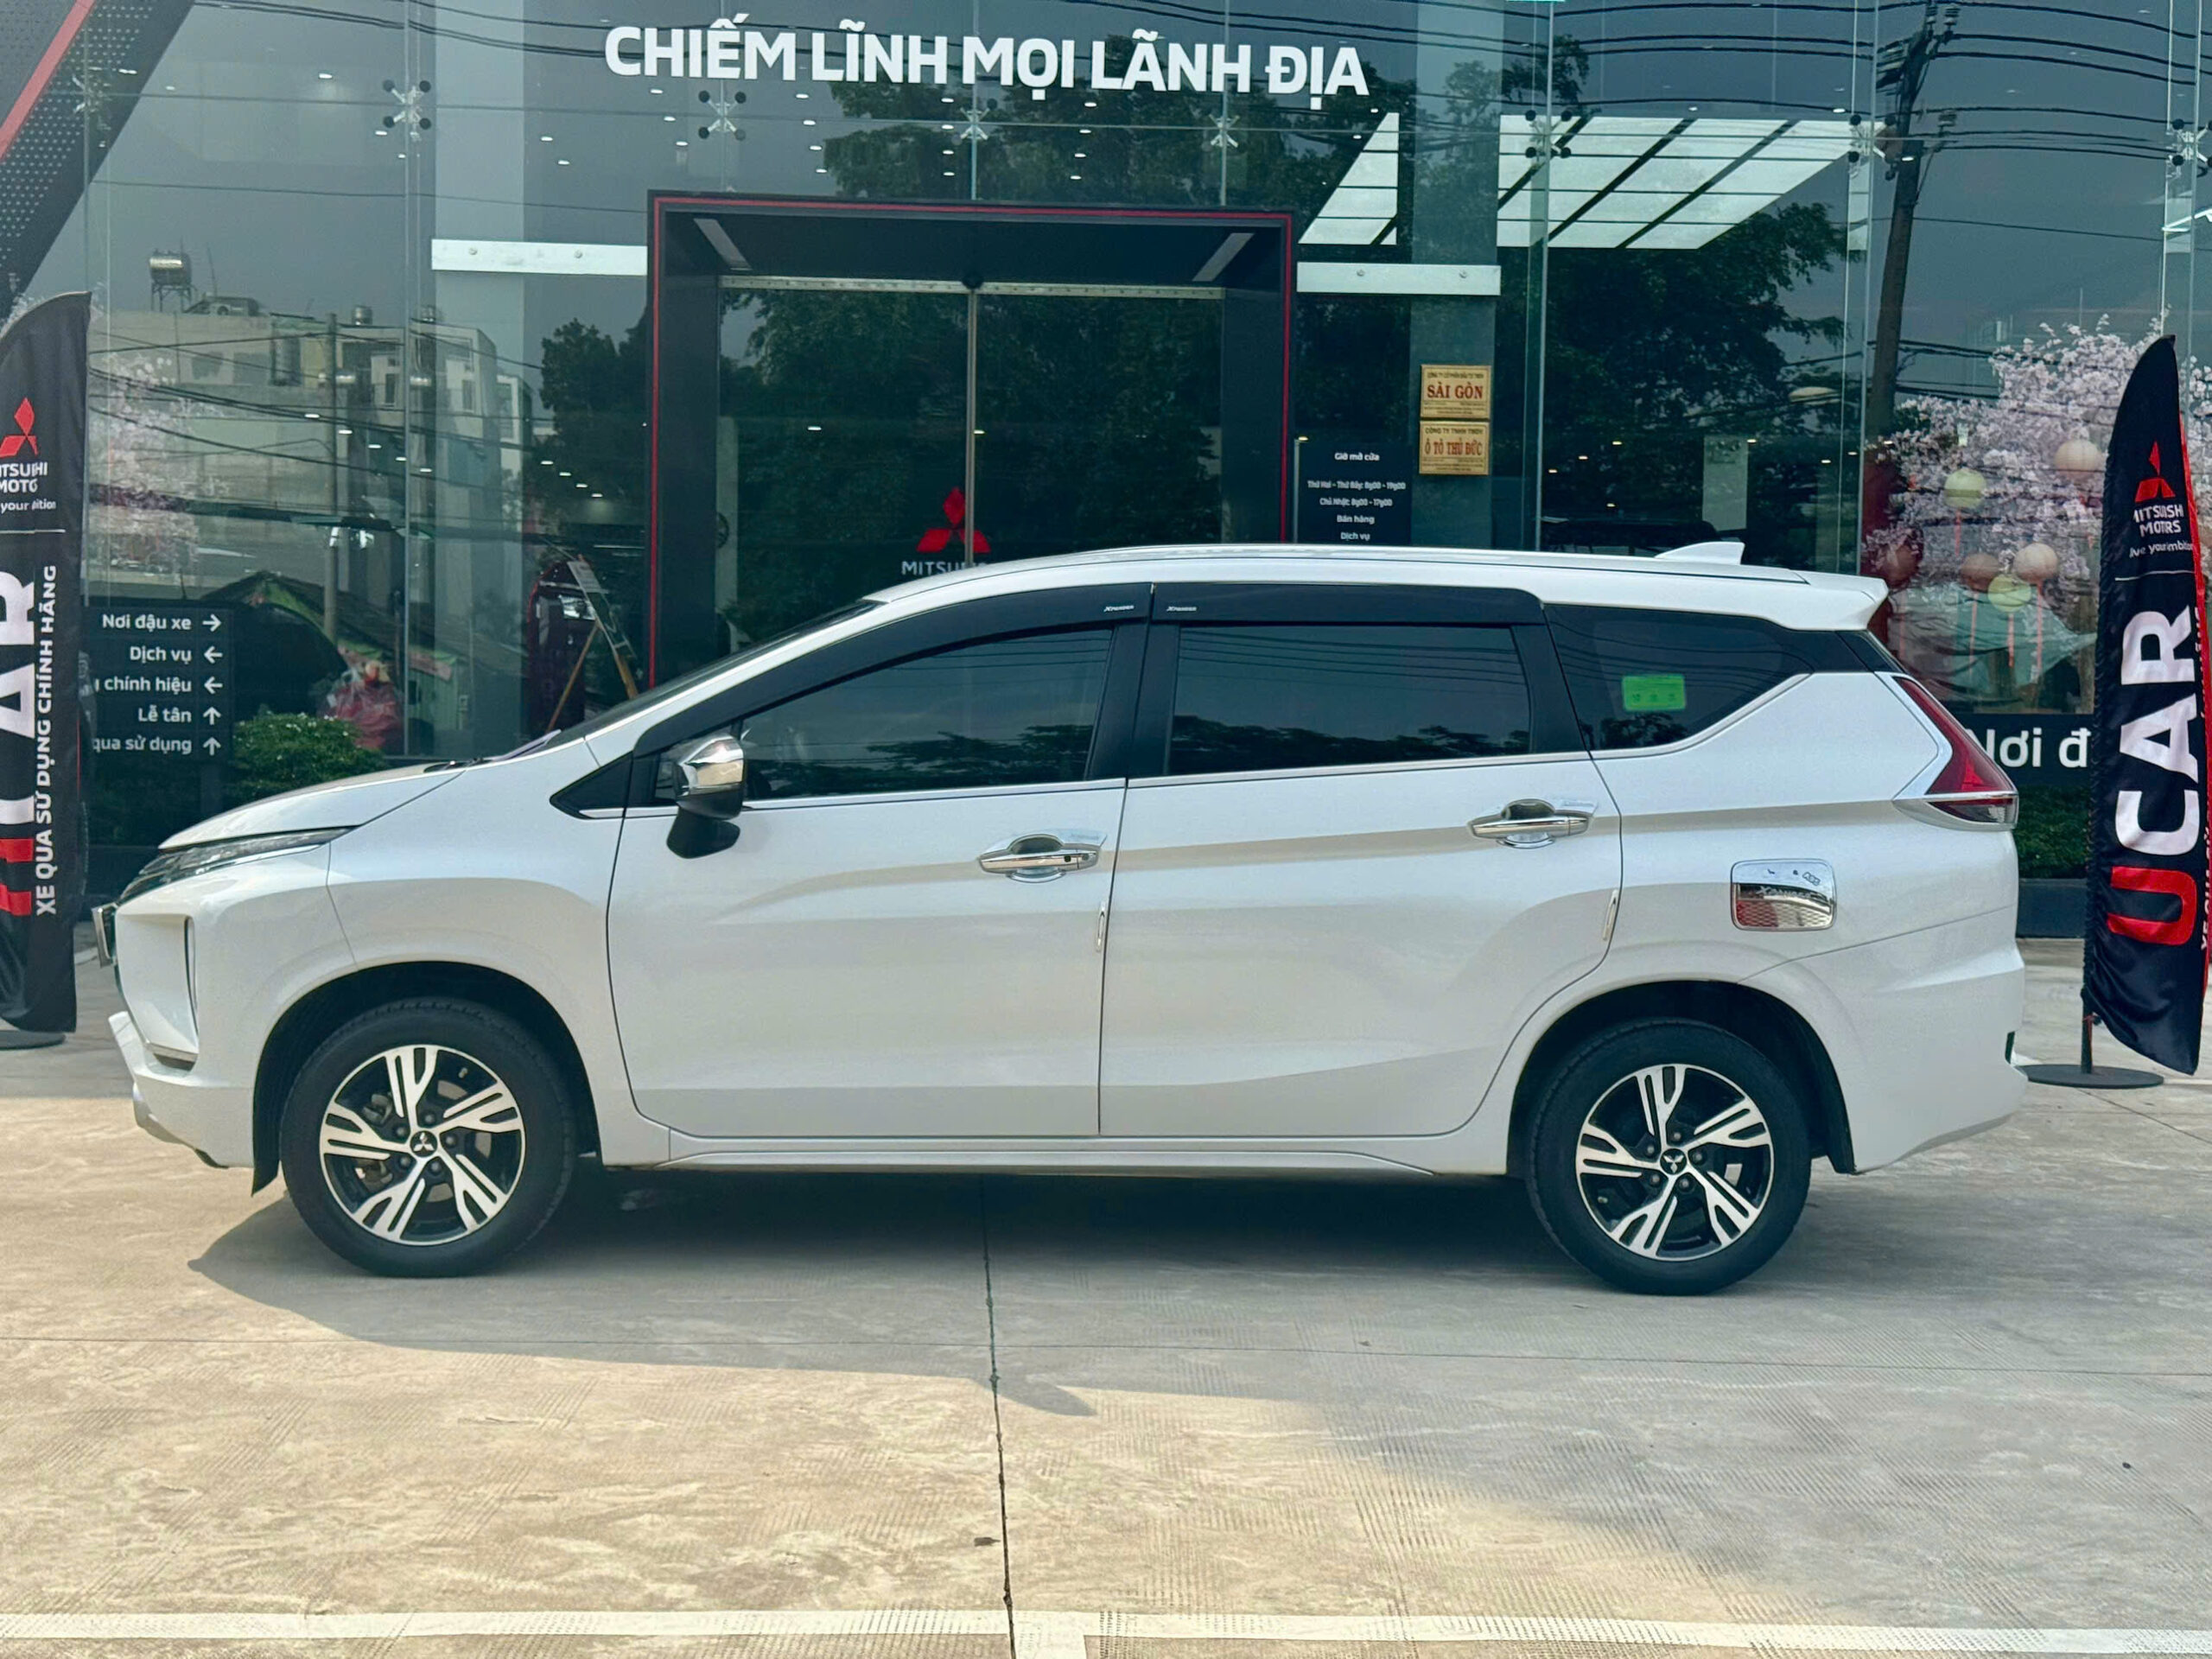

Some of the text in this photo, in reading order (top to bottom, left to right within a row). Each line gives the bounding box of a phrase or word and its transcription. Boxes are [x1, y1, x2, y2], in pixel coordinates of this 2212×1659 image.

[605, 13, 1370, 110] CHIẾM LĨNH MỌI LÃNH ĐỊA
[1427, 381, 1484, 399] SÀI GÒN
[38, 565, 57, 633] HÃNG
[102, 613, 193, 632] Nơi đậu xe
[130, 645, 193, 664] Dịch vụ
[36, 639, 54, 714] CHÍNH
[104, 676, 151, 691] chính
[156, 677, 193, 696] hiệu
[138, 704, 193, 722] Lễ tân
[36, 719, 56, 786] DỤNG
[125, 734, 147, 751] sử
[149, 736, 193, 755] dụng
[2107, 604, 2200, 946] UCAR
[35, 830, 58, 880] QUA
[36, 884, 57, 916] XE
